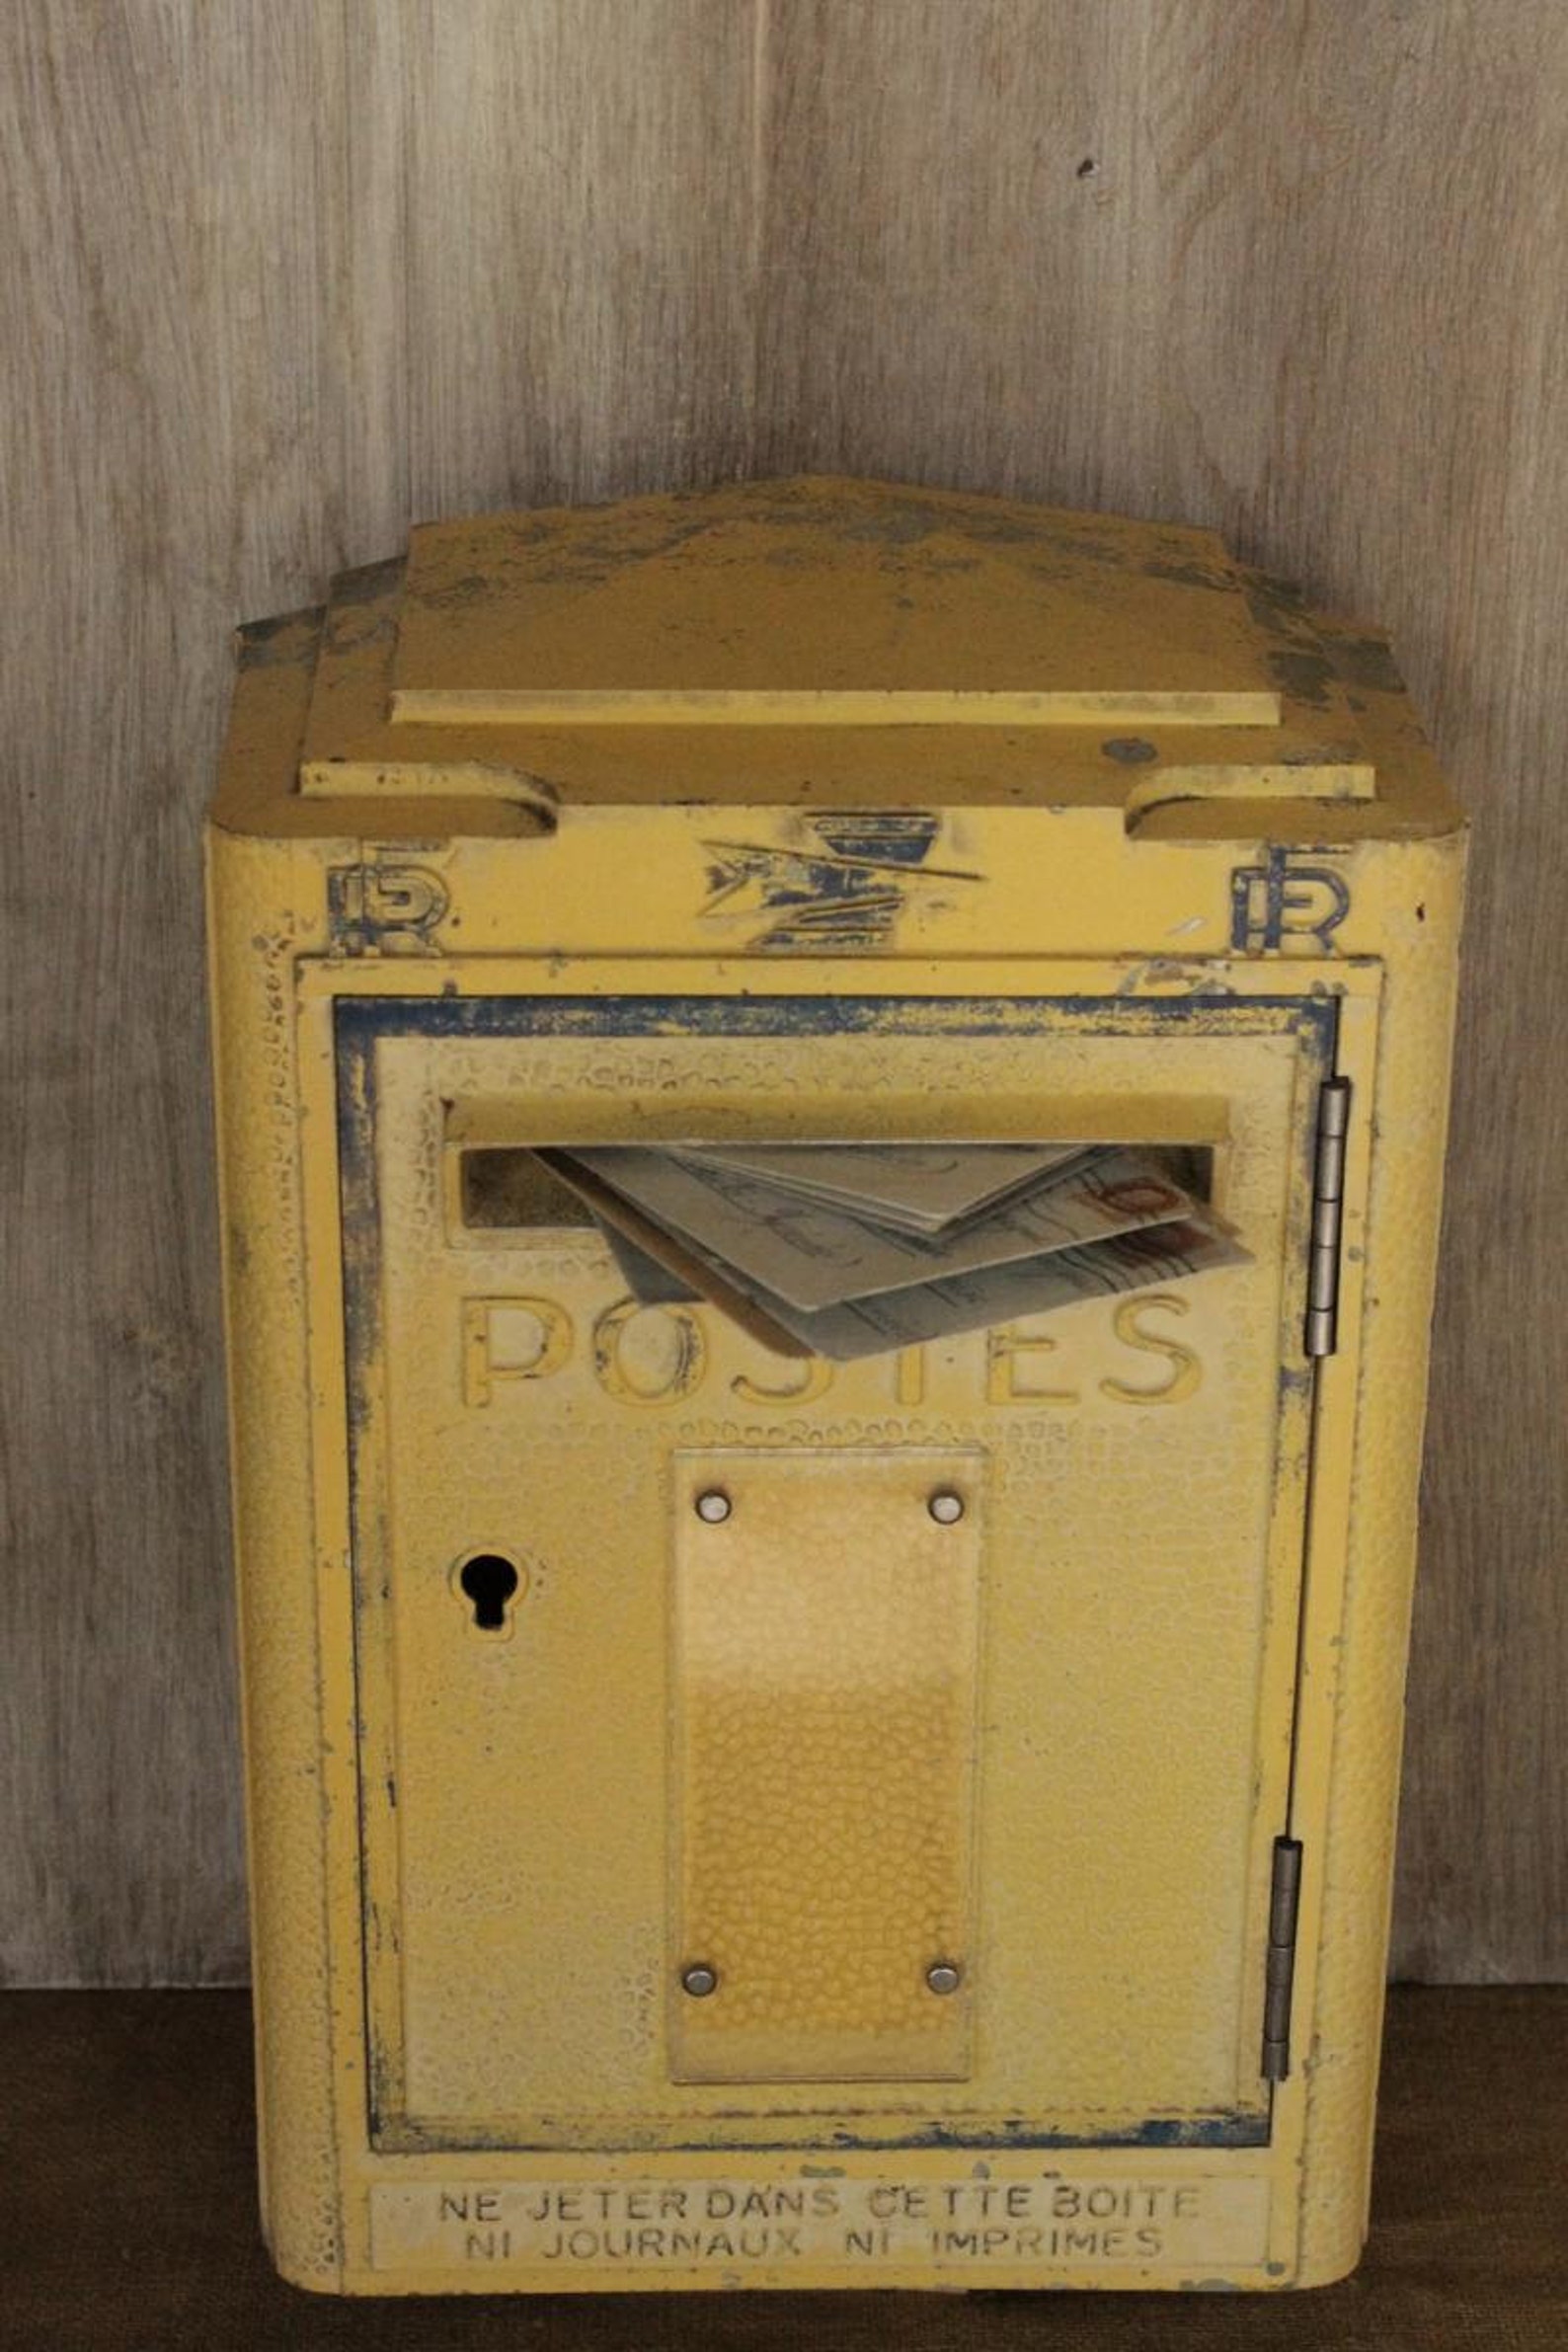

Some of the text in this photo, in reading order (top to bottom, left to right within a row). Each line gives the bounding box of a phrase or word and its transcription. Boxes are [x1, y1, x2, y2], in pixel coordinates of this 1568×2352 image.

[439, 2185, 1201, 2222] NE JETER DANS CETTE BOITE
[465, 2227, 1164, 2259] NI JOURNAUX NI IMPRIMES
